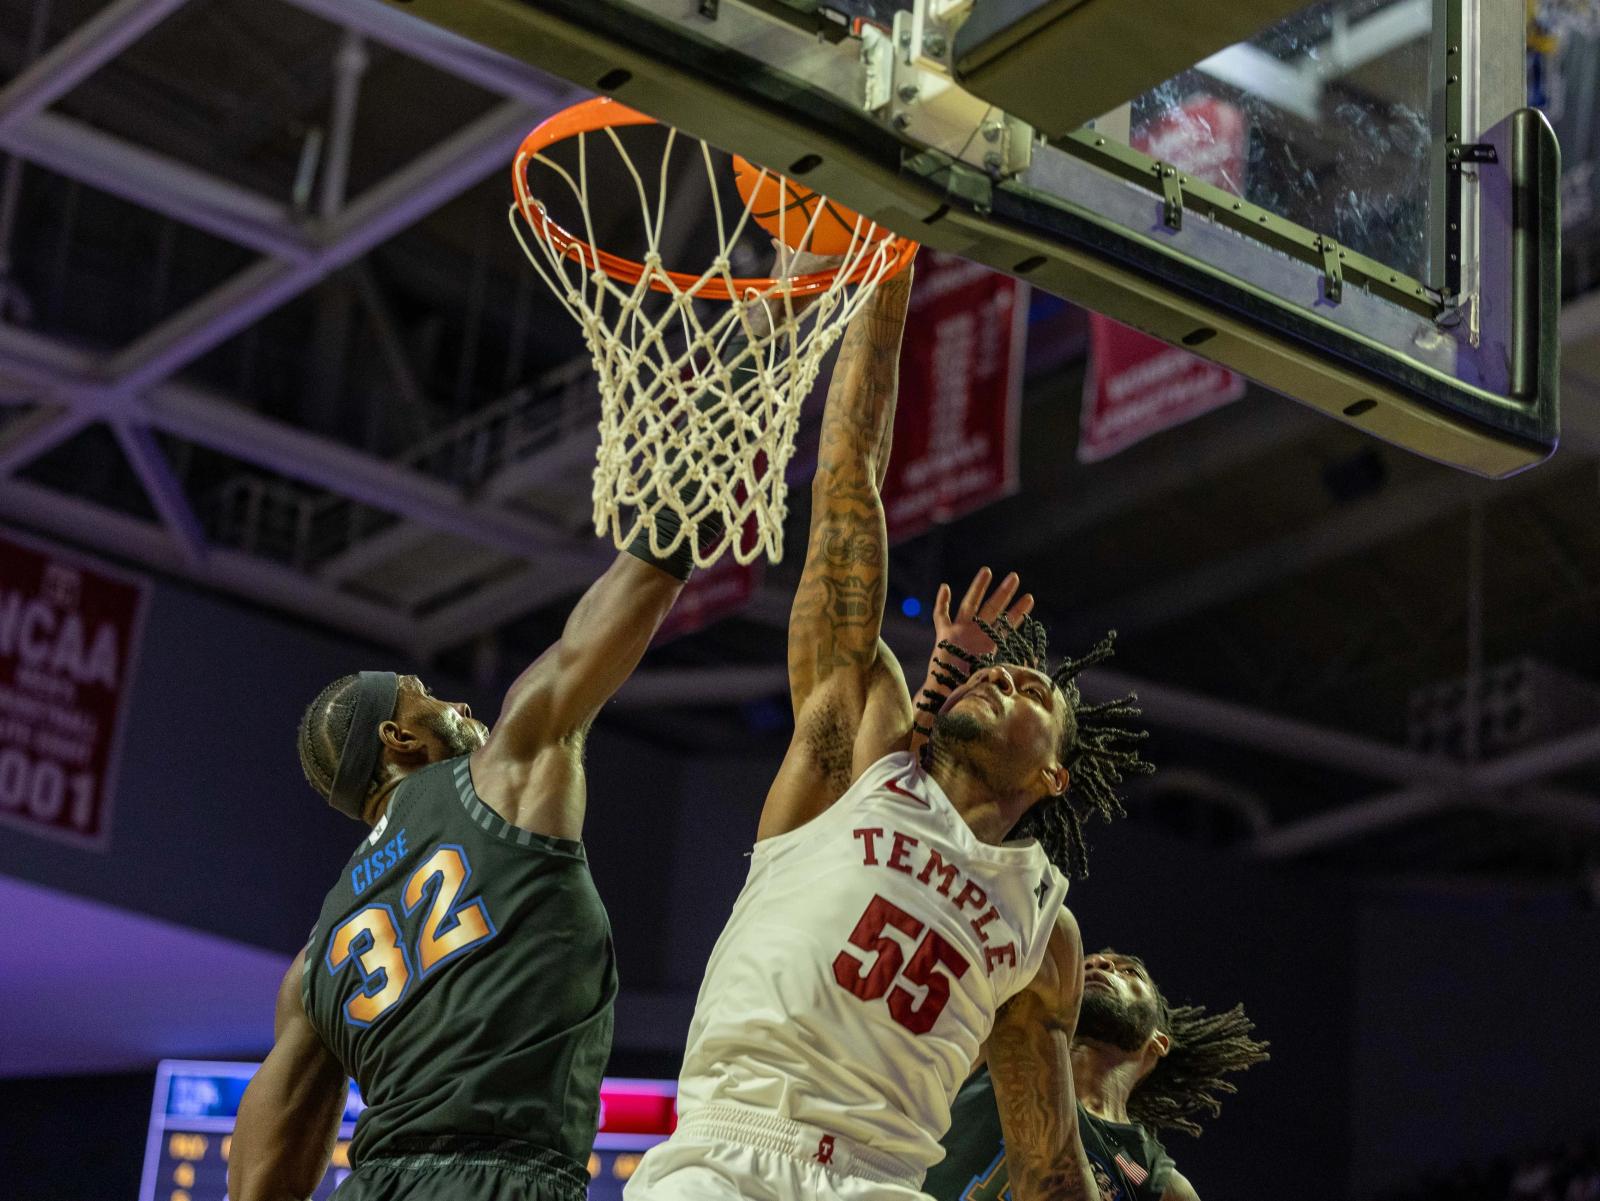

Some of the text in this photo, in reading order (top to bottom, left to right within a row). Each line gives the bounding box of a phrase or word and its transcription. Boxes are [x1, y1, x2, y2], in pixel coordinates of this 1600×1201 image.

[351, 828, 409, 896] CISSE
[853, 827, 1016, 978] TEMPLE
[324, 843, 498, 1029] 32
[832, 893, 970, 1035] 55
